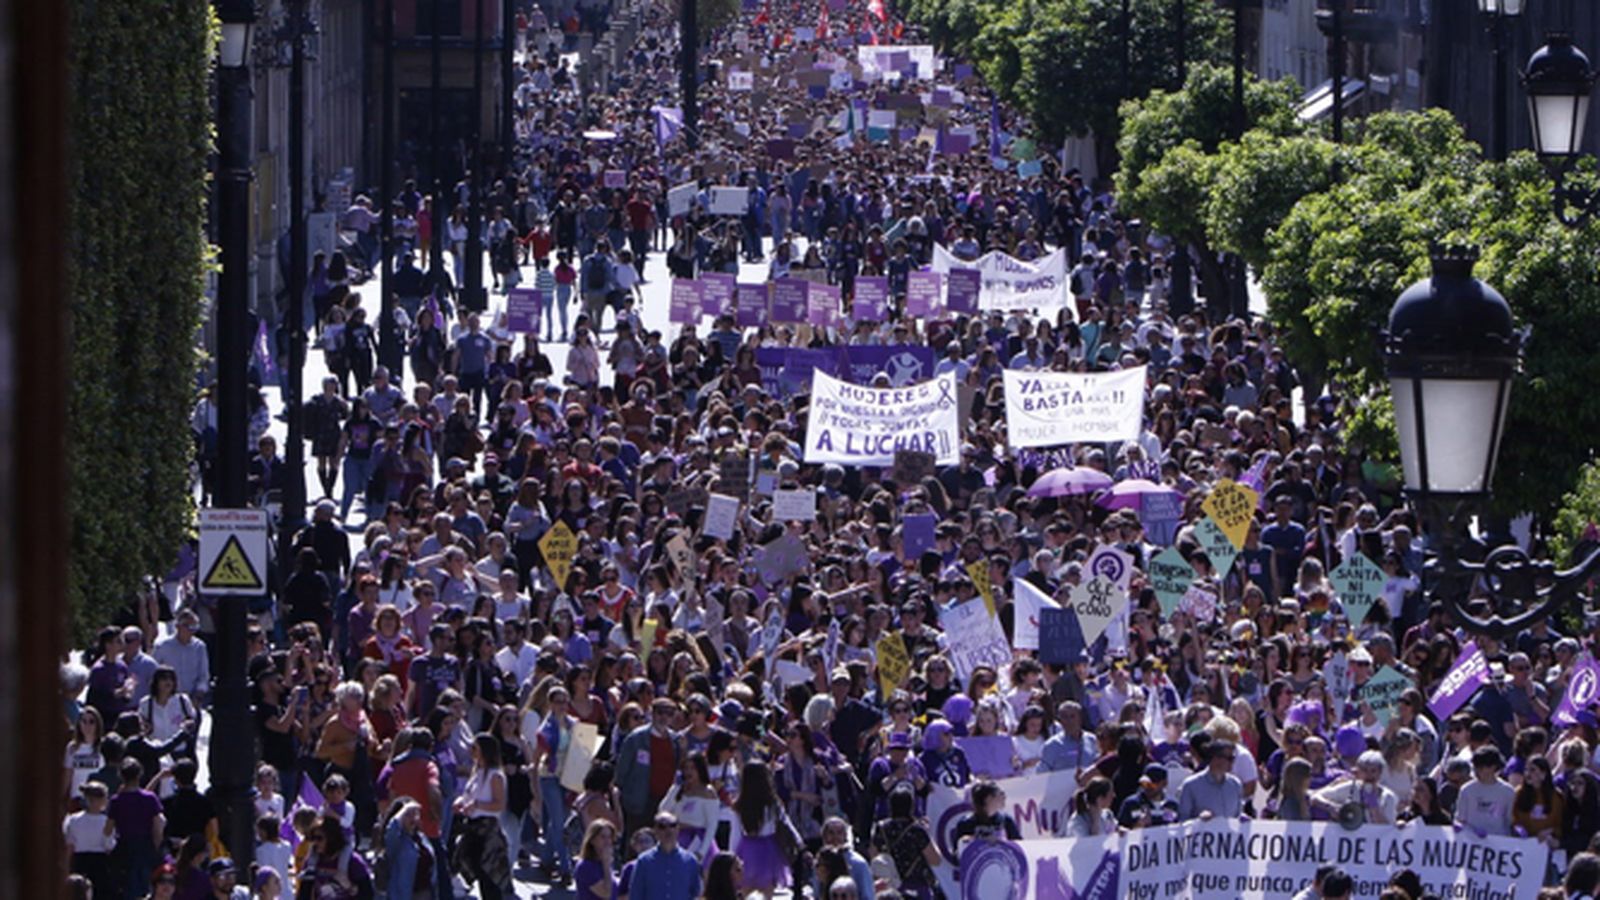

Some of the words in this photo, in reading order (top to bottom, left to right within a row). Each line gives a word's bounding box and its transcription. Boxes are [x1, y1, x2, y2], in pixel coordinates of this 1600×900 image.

[816, 429, 833, 452] A
[1350, 556, 1364, 567] NI
[1336, 568, 1383, 581] SANTA
[1348, 581, 1364, 592] NI
[1341, 592, 1373, 606] PUTA
[1128, 837, 1159, 872] DÍA
[1166, 832, 1328, 865] INTERNACIONAL
[1337, 837, 1366, 865] DE
[1374, 837, 1414, 867] LAS
[1421, 839, 1523, 879] MUJERES
[1128, 880, 1159, 900] Hoy
[1191, 873, 1230, 894] que
[1441, 877, 1516, 900] realidad
